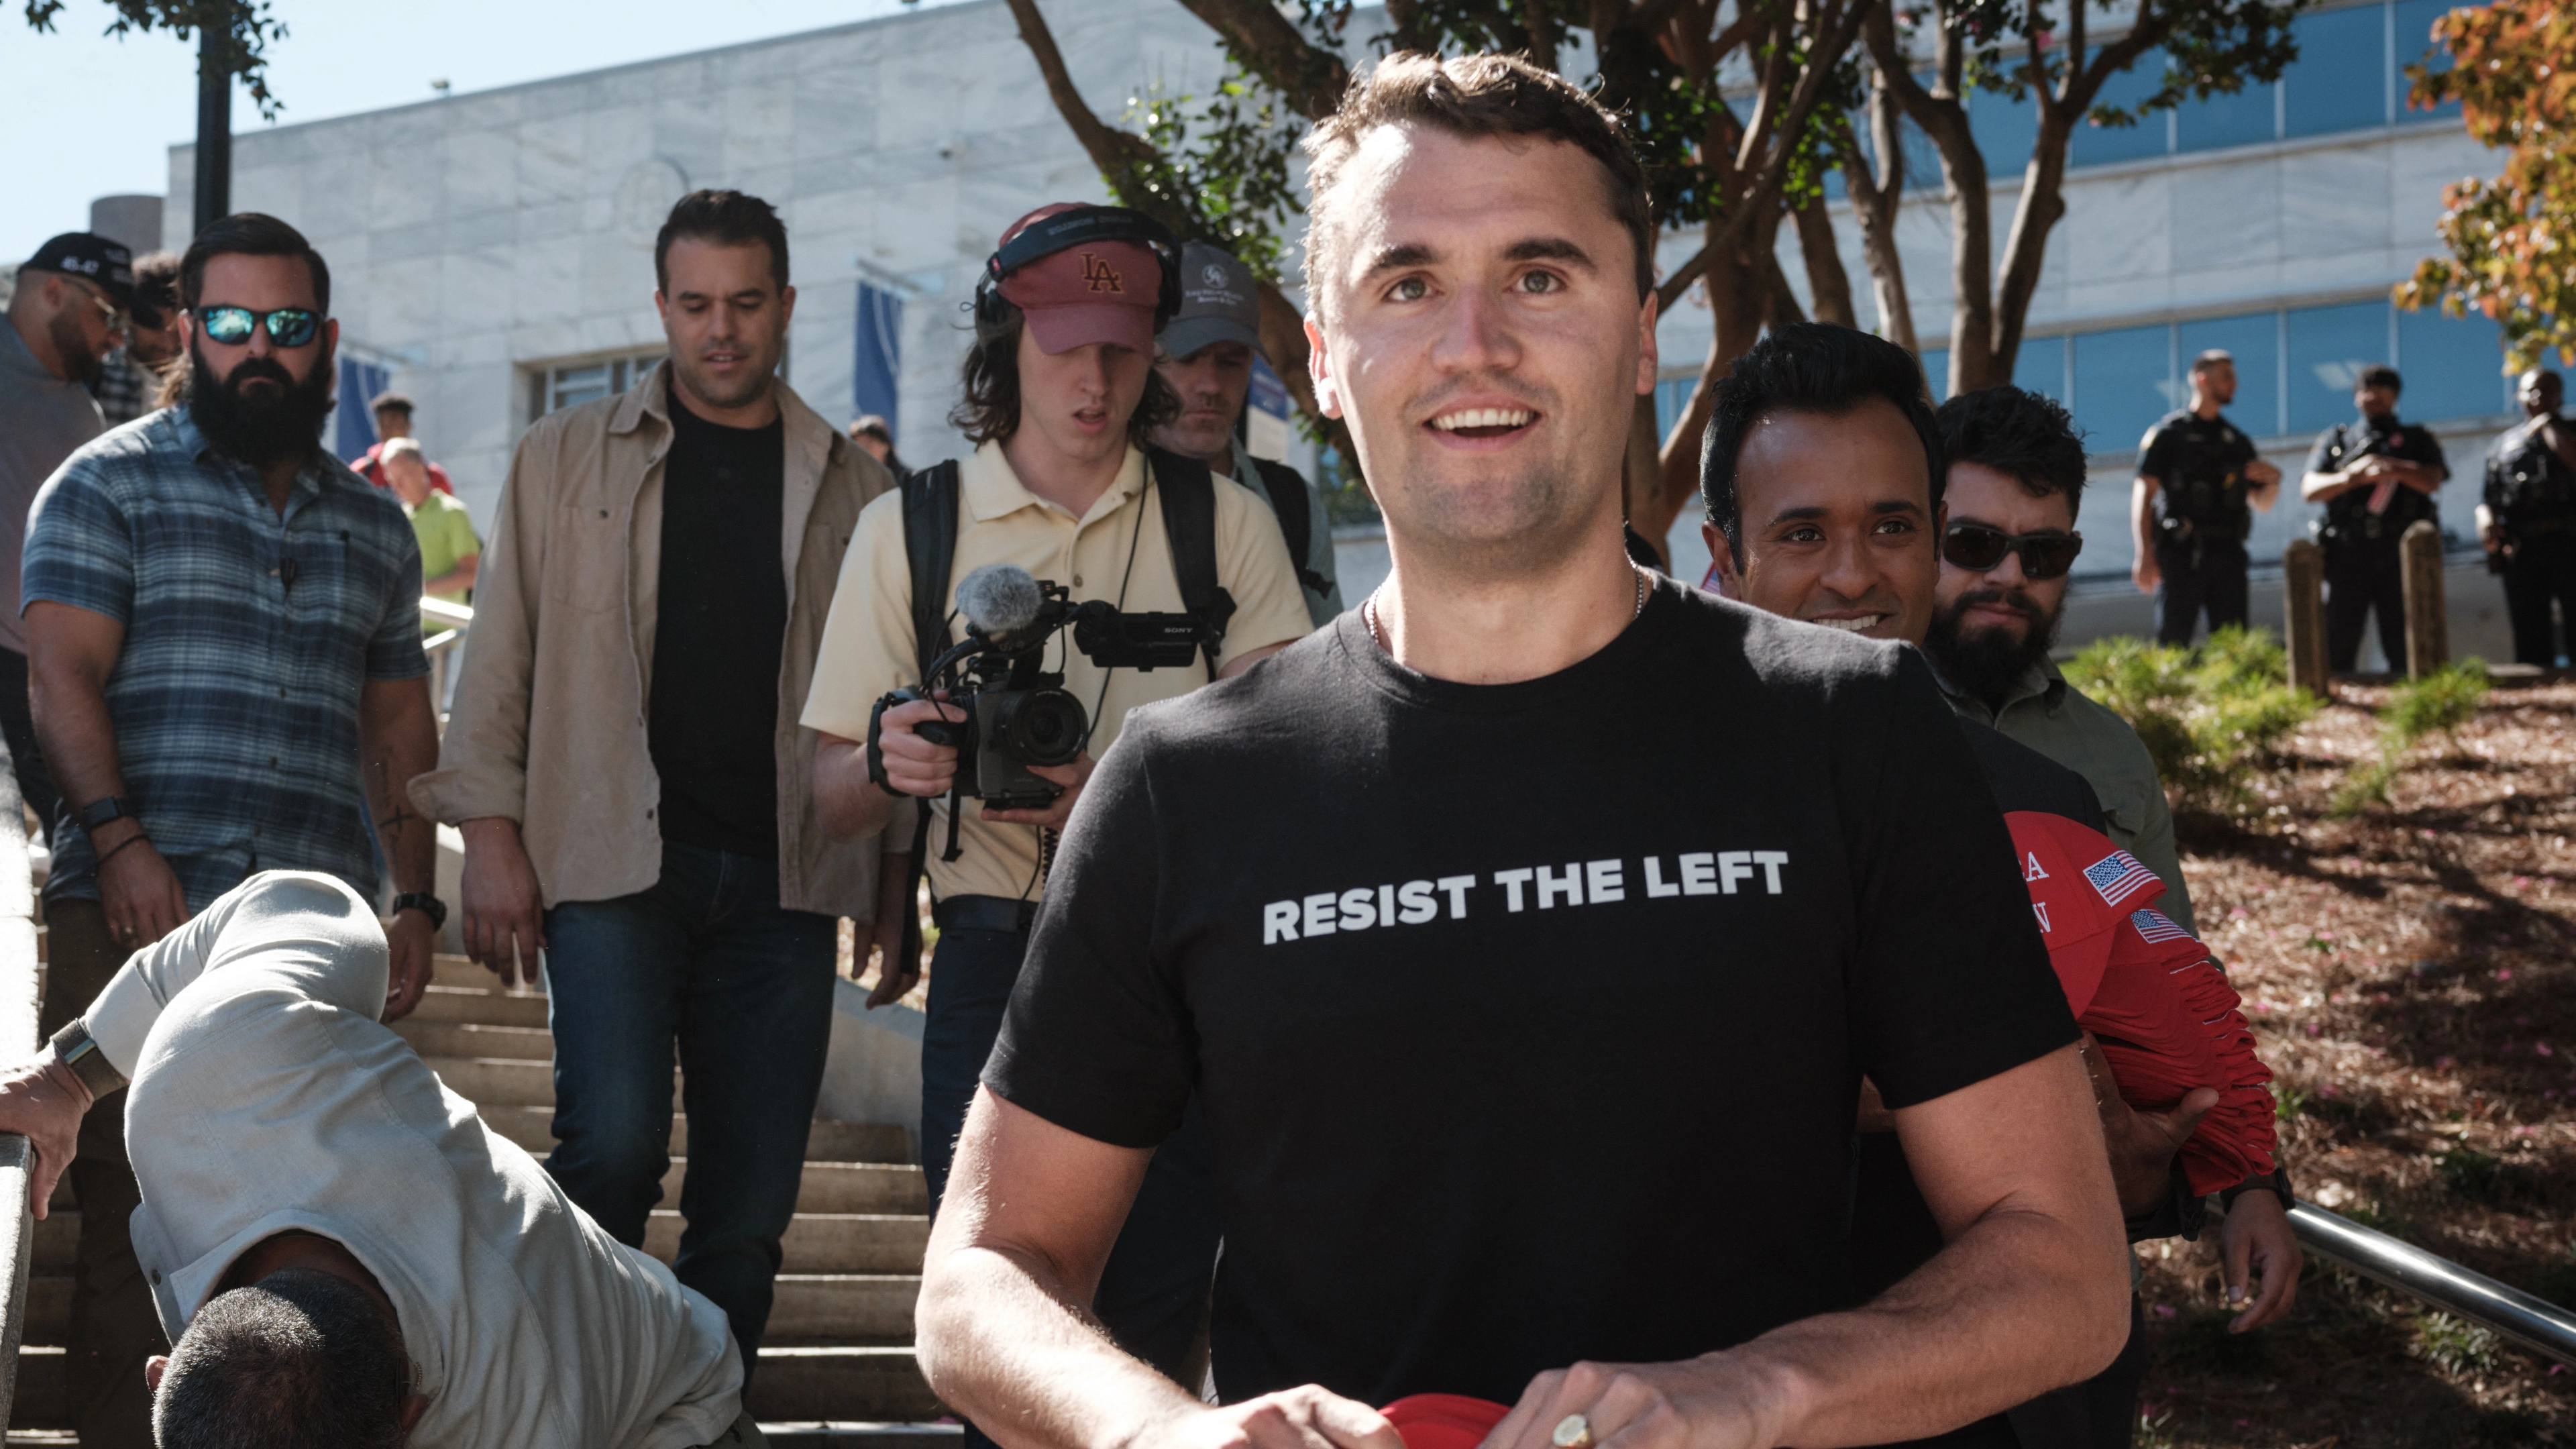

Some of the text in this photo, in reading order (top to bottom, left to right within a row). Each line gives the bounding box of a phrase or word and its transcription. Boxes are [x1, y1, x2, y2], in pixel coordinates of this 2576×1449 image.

[1081, 253, 1124, 293] LA
[2018, 851, 2050, 882] A
[1263, 850, 1789, 945] RESIST THE LEFT
